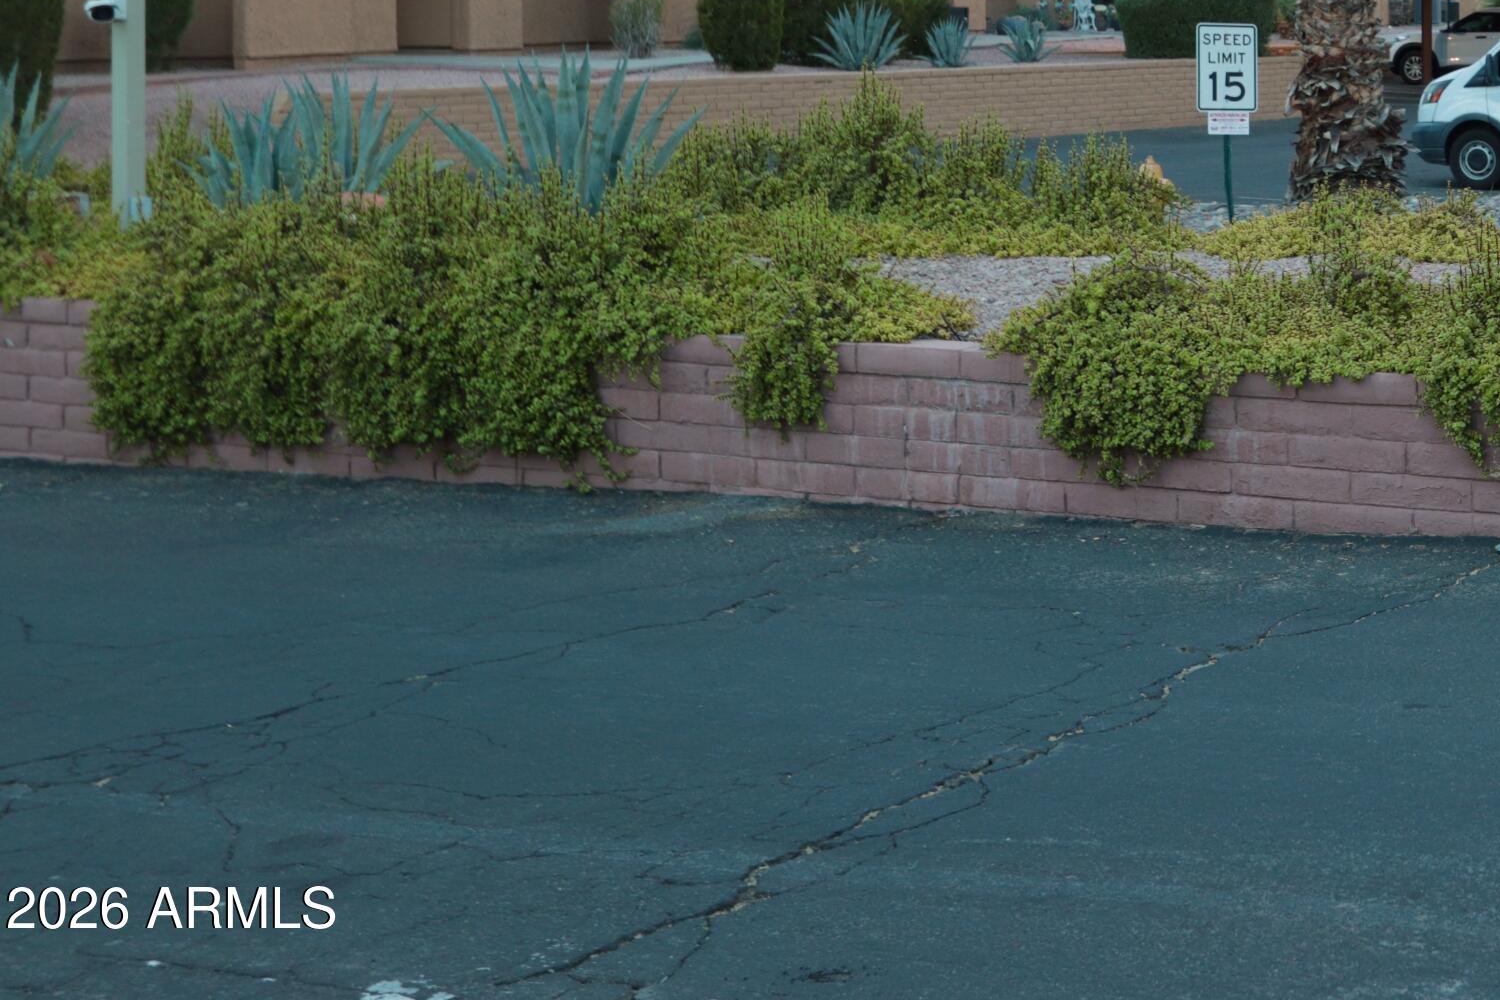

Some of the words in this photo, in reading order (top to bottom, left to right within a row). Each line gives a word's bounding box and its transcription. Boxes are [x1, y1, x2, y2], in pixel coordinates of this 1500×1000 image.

[1202, 33, 1252, 46] SPEED
[1207, 52, 1246, 64] LIMIT
[1208, 71, 1246, 102] 15
